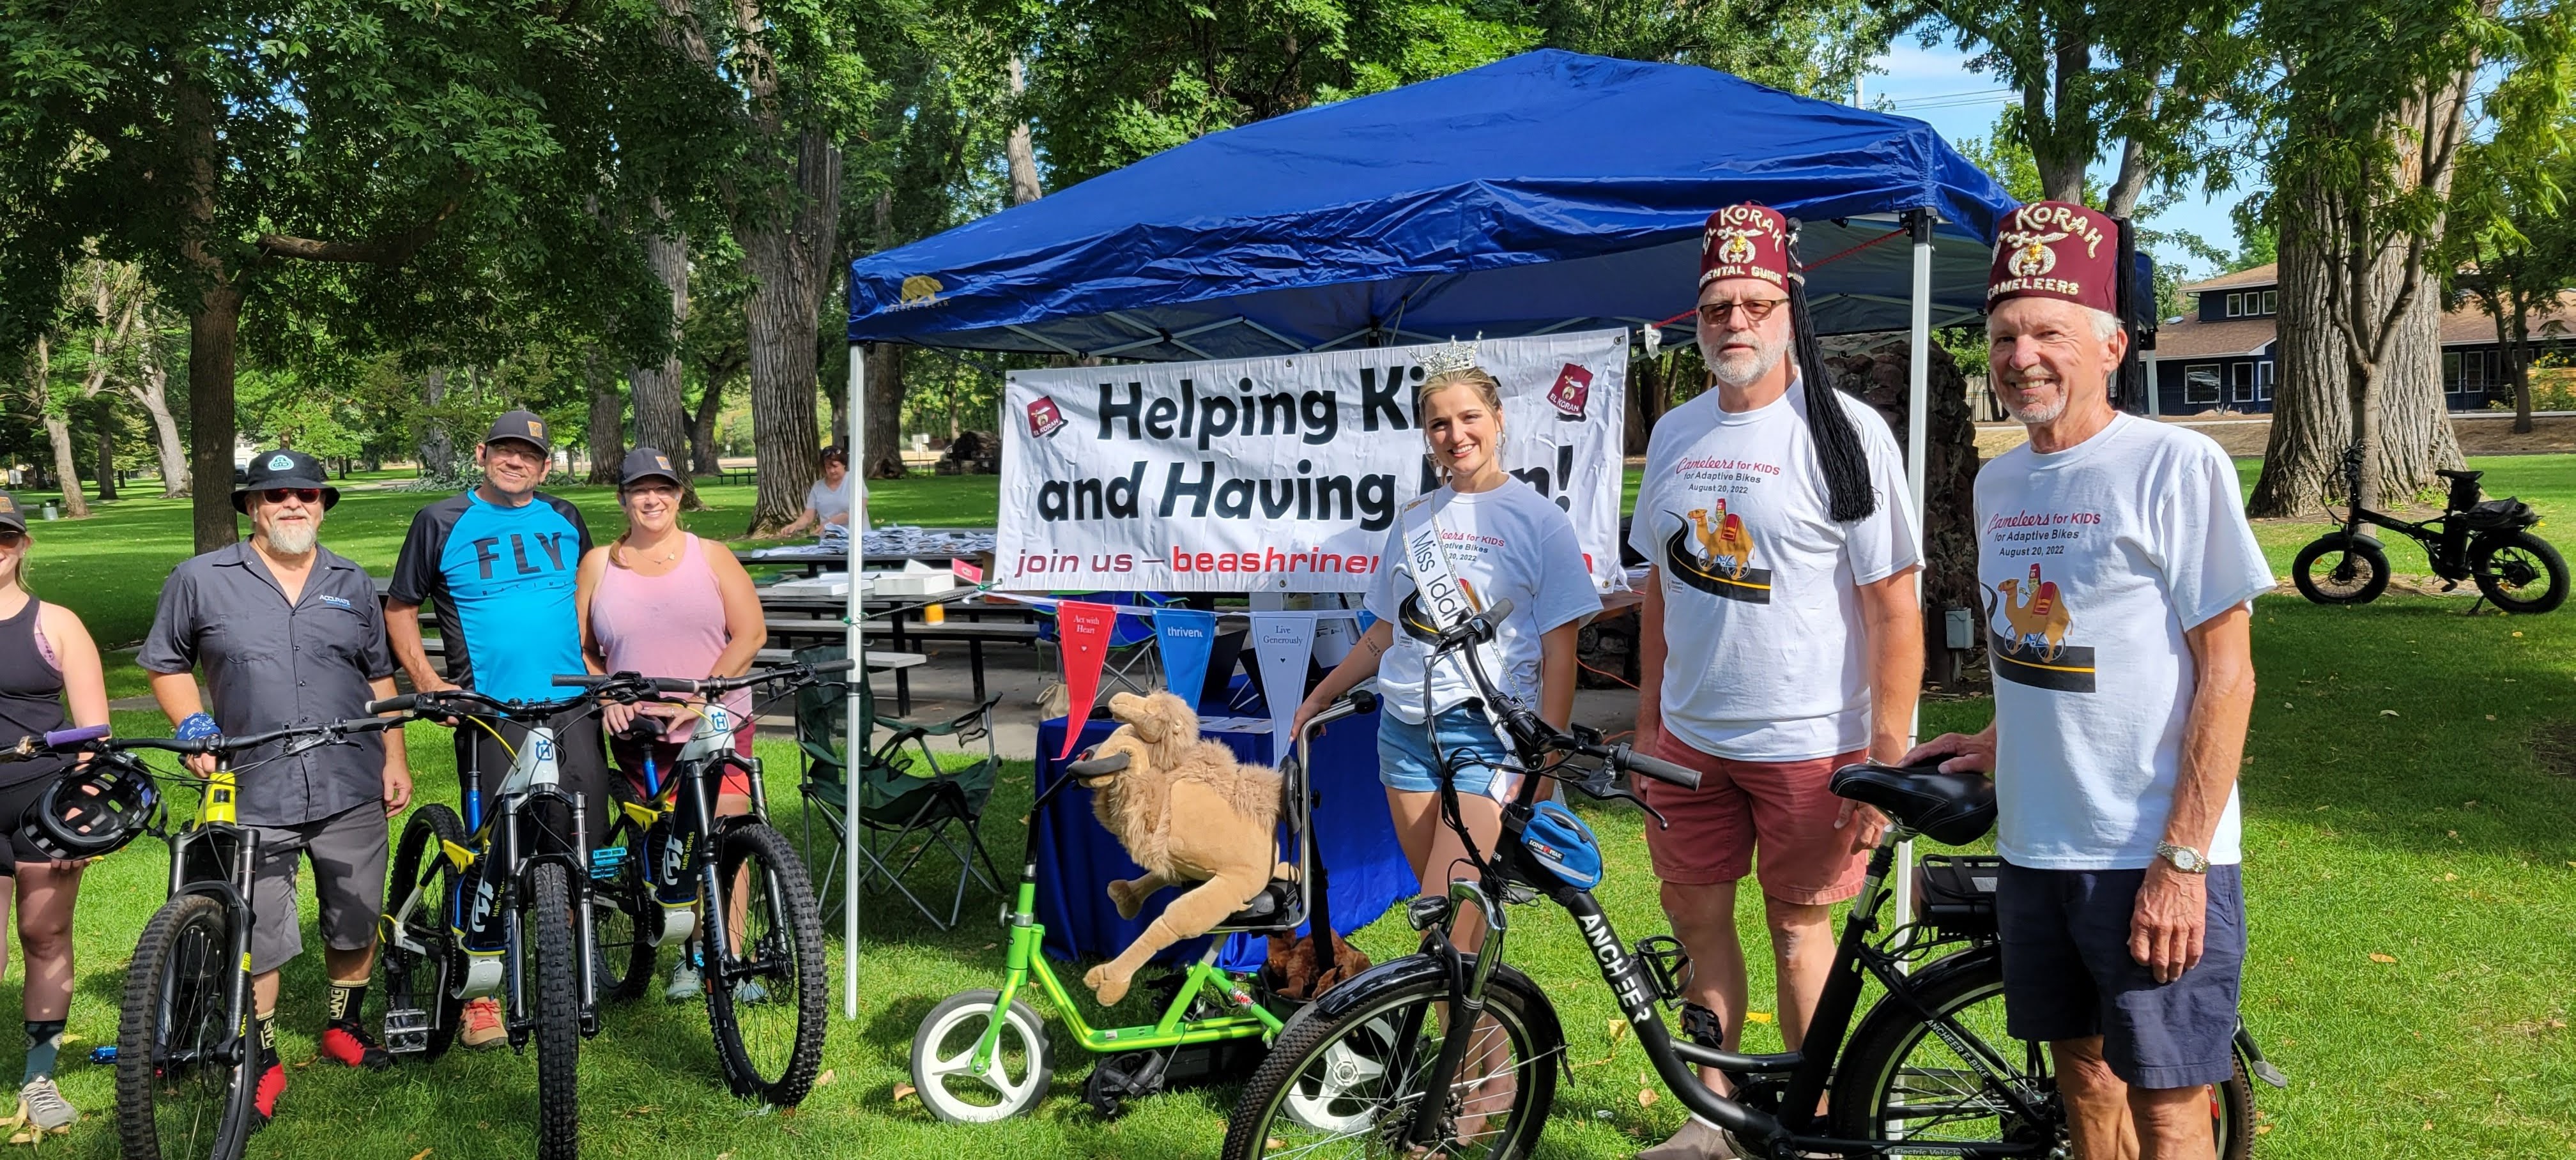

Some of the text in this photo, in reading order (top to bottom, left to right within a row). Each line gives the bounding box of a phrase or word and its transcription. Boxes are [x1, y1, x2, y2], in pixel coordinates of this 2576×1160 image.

[1720, 204, 1782, 252] KORAH
[2016, 202, 2103, 259] KORAH
[1751, 266, 1782, 285] GUIDE
[1549, 393, 1579, 412] EL KORAH
[1097, 377, 1338, 451] Helping
[1039, 419, 1059, 434] KORAH
[1676, 455, 1781, 476] Cameleers for KIDS
[1683, 471, 1761, 484] for Adaptive Bikes
[1037, 460, 1148, 522] and
[1158, 459, 1395, 531] Having
[1688, 484, 1749, 494] August 20, 2022
[1987, 510, 2101, 535] Cameleers for KIDS
[1482, 536, 1505, 547] KIDS
[1994, 529, 2080, 543] for Adaptive Bikes
[472, 531, 567, 580] FLY
[1412, 530, 1436, 573] Miss
[1465, 544, 1489, 553] Bikes
[1999, 546, 2064, 558] August 20, 2022
[1015, 548, 1079, 578] join
[1091, 553, 1133, 573] us
[1073, 614, 1085, 623] Act
[1077, 624, 1095, 634] Heart
[1275, 625, 1291, 634] Live
[1263, 635, 1303, 646] Generously
[682, 832, 695, 870] HARD CROSS
[1529, 840, 1544, 851] LONE
[1549, 849, 1563, 859] PEAK
[1578, 913, 1652, 1024] ANCHEER
[1925, 1019, 1991, 1079] ANCHEER E-BIKE
